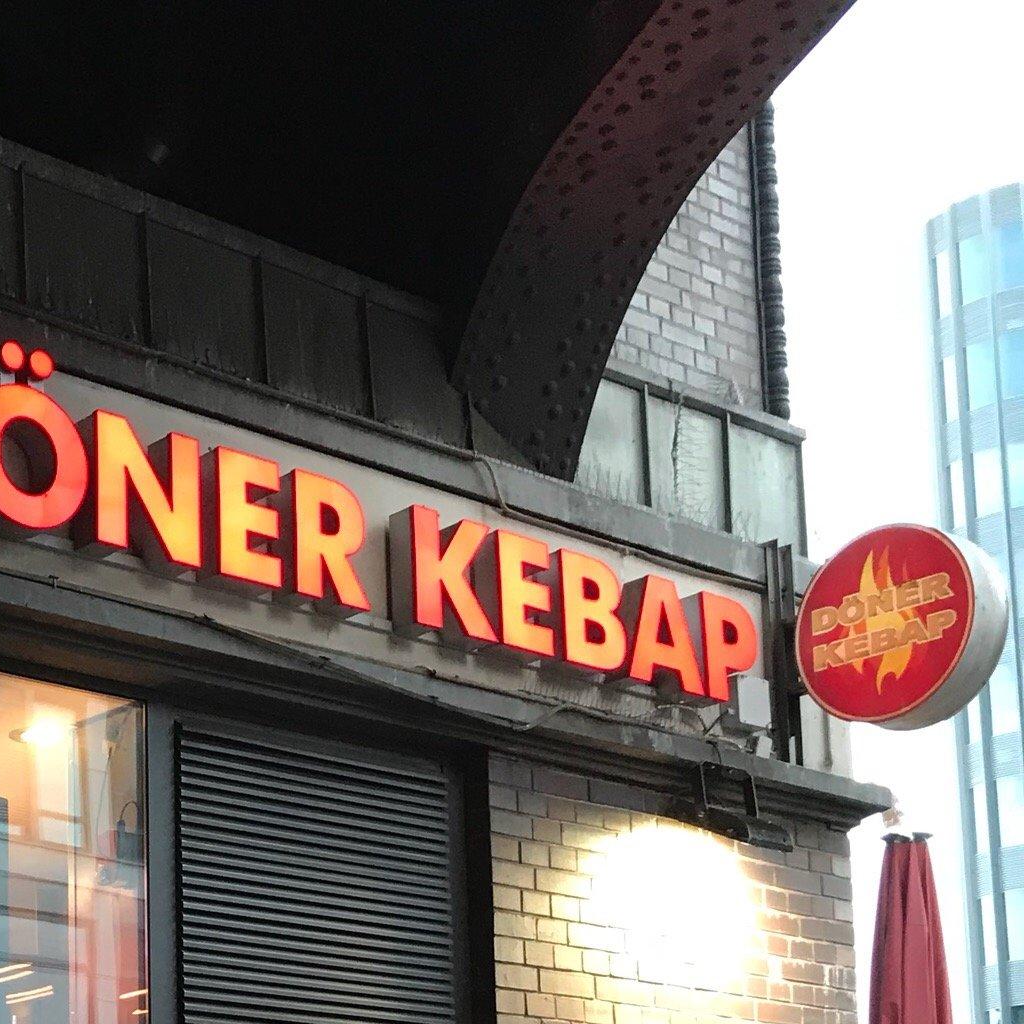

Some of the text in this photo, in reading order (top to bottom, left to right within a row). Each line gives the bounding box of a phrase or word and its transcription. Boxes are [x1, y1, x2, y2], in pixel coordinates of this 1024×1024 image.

[409, 503, 758, 703] KEBAP
[812, 572, 954, 636] DÖNER
[813, 609, 957, 672] KEBAP
